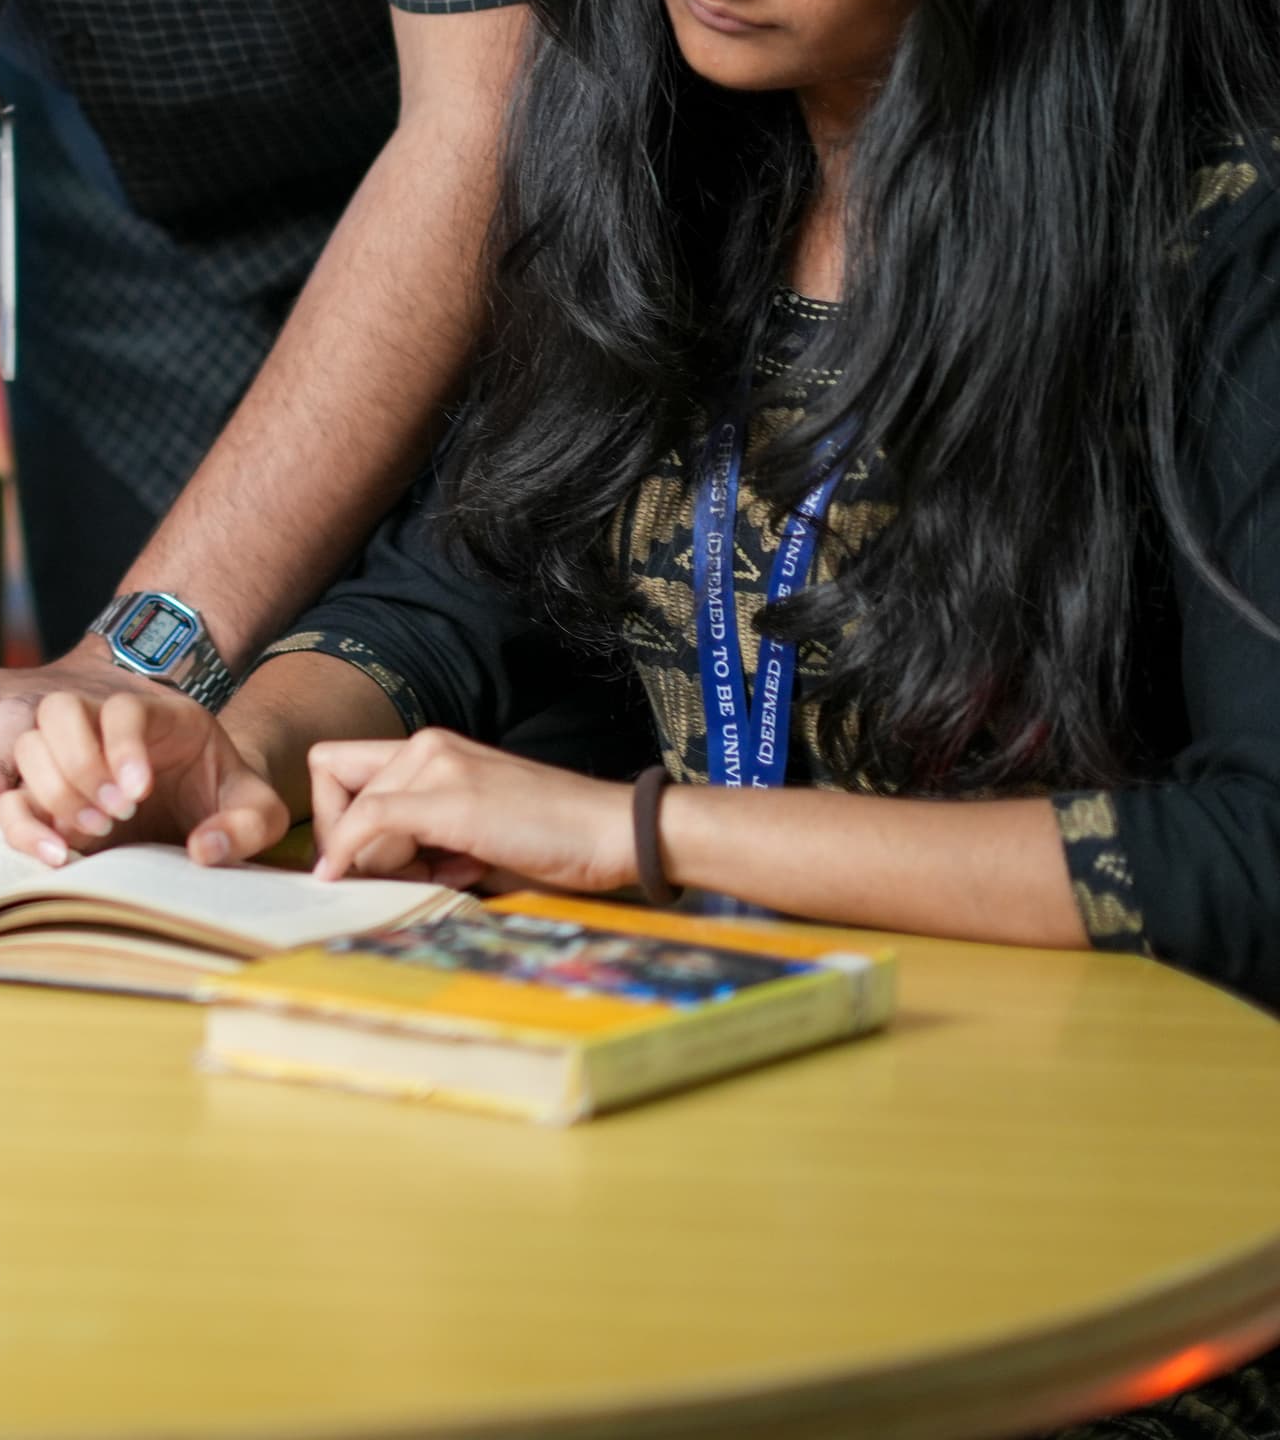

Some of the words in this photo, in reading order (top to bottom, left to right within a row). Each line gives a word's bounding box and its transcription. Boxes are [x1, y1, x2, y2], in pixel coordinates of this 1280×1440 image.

[706, 531, 726, 640] (DEEMED
[712, 645, 730, 678] TO
[716, 684, 736, 717] BE
[756, 659, 781, 765] (DEEMED
